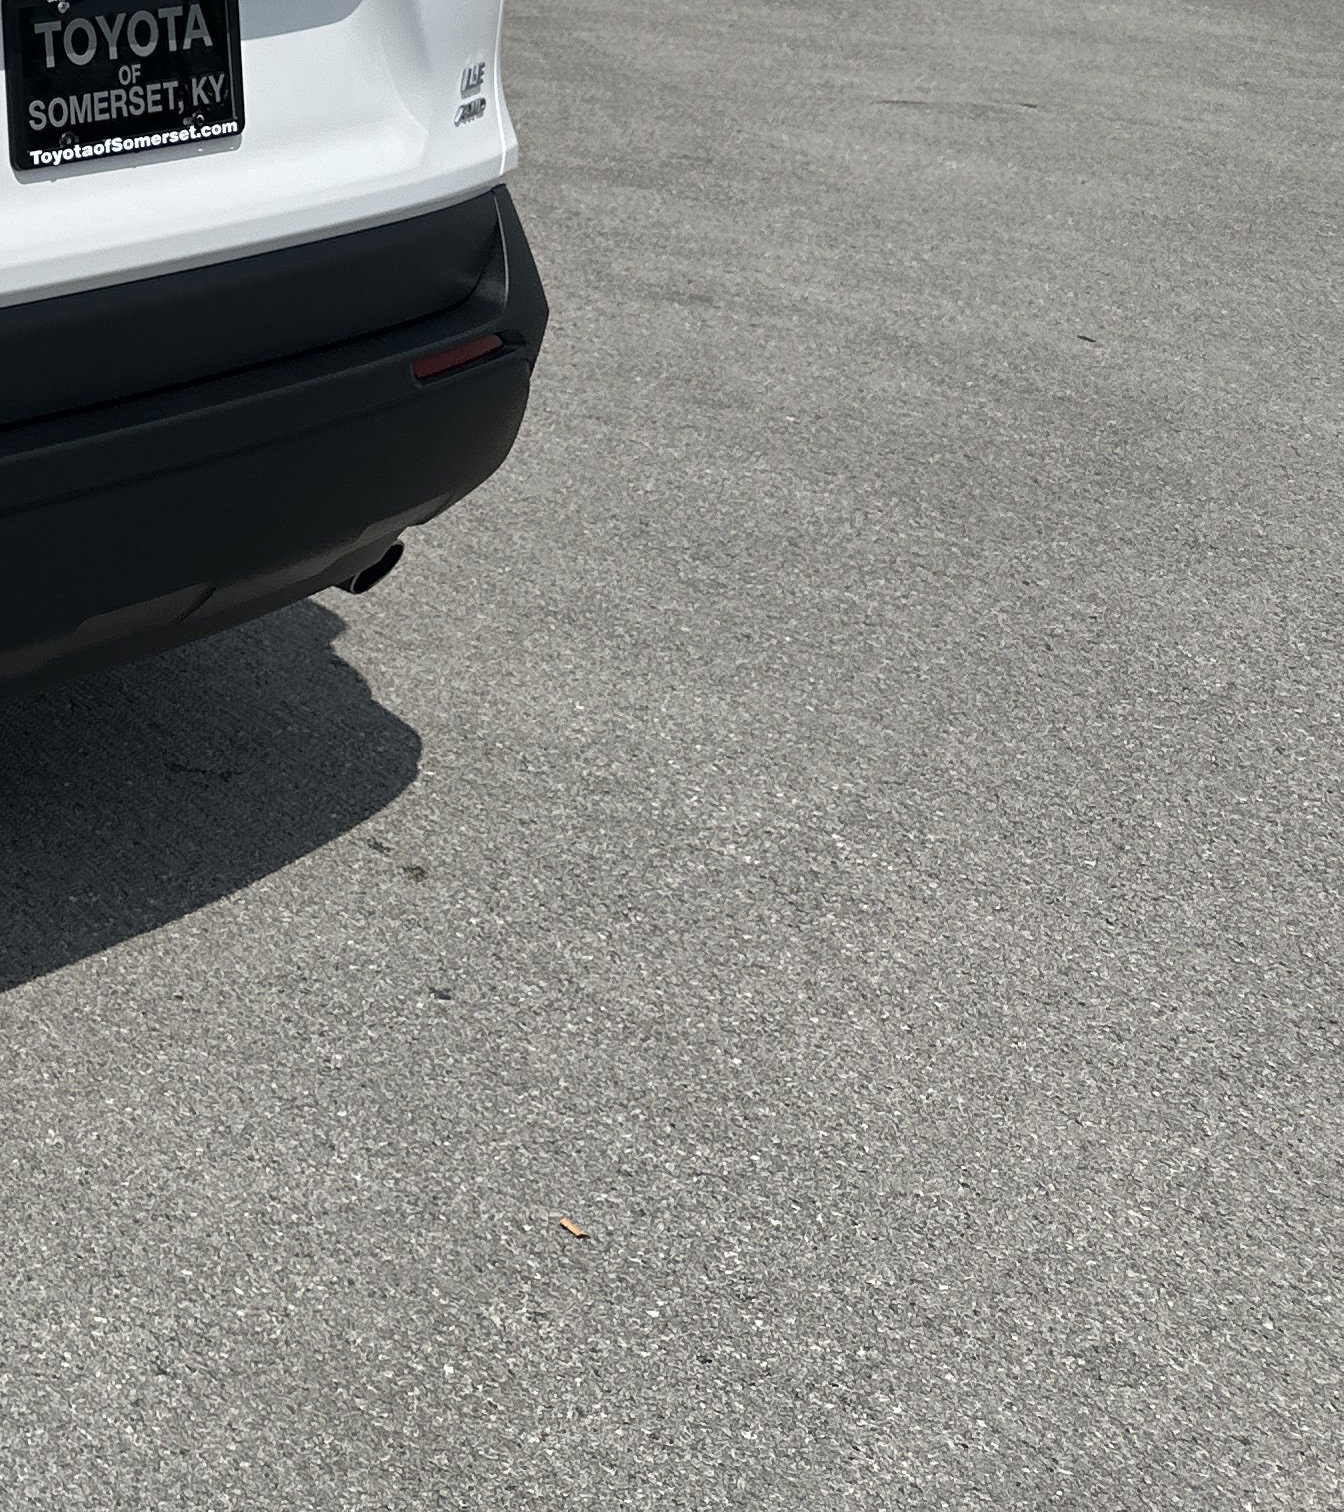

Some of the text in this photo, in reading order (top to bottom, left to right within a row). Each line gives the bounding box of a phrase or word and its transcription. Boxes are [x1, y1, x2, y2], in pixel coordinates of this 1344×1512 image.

[34, 3, 213, 68] TOYOTA
[118, 64, 141, 85] OF
[28, 73, 225, 131] SOMERSET, KY
[29, 119, 238, 166] ToyotaofSomerset.com
